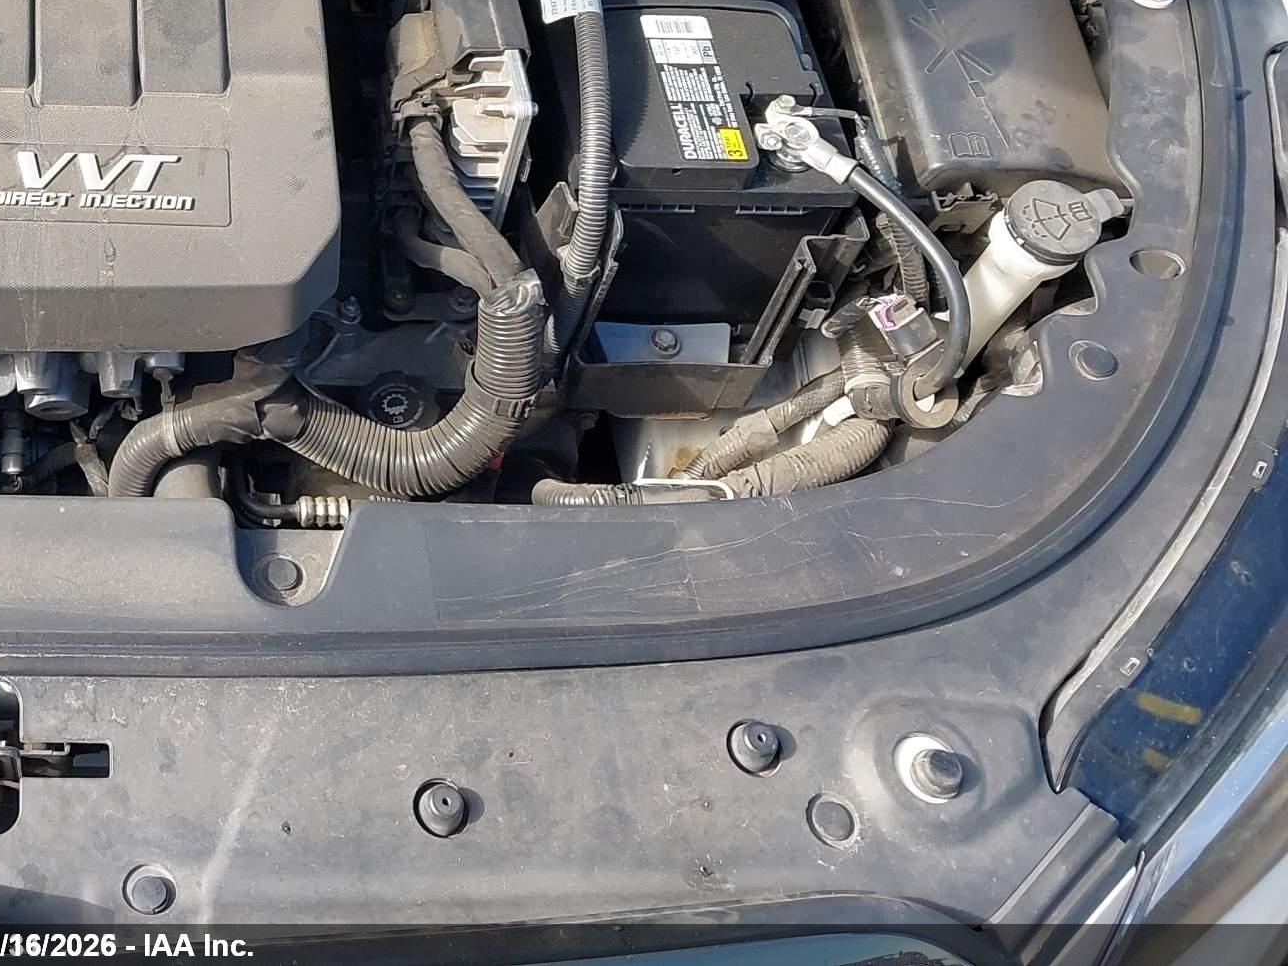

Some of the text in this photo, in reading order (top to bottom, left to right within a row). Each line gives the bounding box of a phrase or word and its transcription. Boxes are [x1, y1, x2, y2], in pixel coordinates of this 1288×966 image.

[702, 45, 713, 58] Pb
[670, 103, 699, 160] DURACELL
[727, 149, 743, 157] 3
[16, 151, 182, 193] VVT
[79, 192, 195, 211] INJECTION
